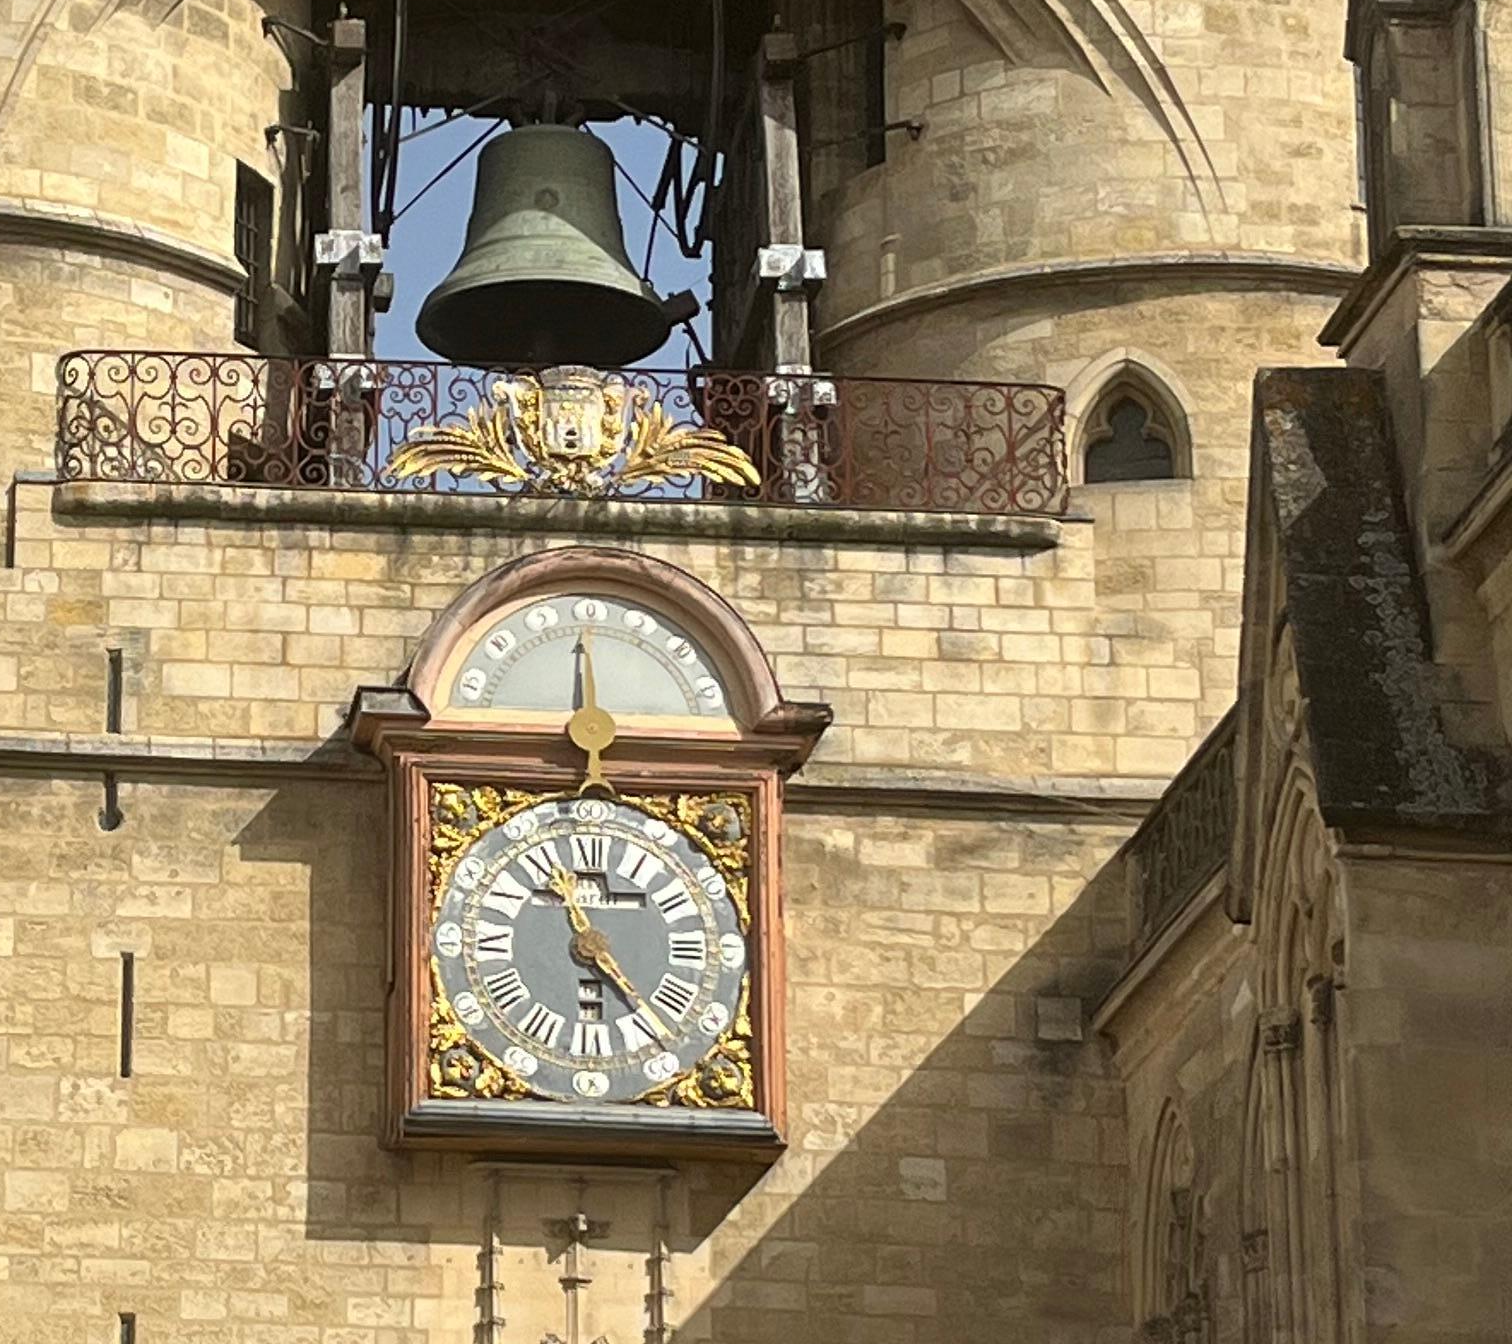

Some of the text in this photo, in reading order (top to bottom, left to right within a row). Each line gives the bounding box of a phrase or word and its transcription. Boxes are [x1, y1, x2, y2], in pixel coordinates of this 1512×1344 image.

[586, 604, 595, 617] 0
[575, 837, 603, 868] XII
[659, 891, 689, 914] II
[671, 940, 704, 960] III
